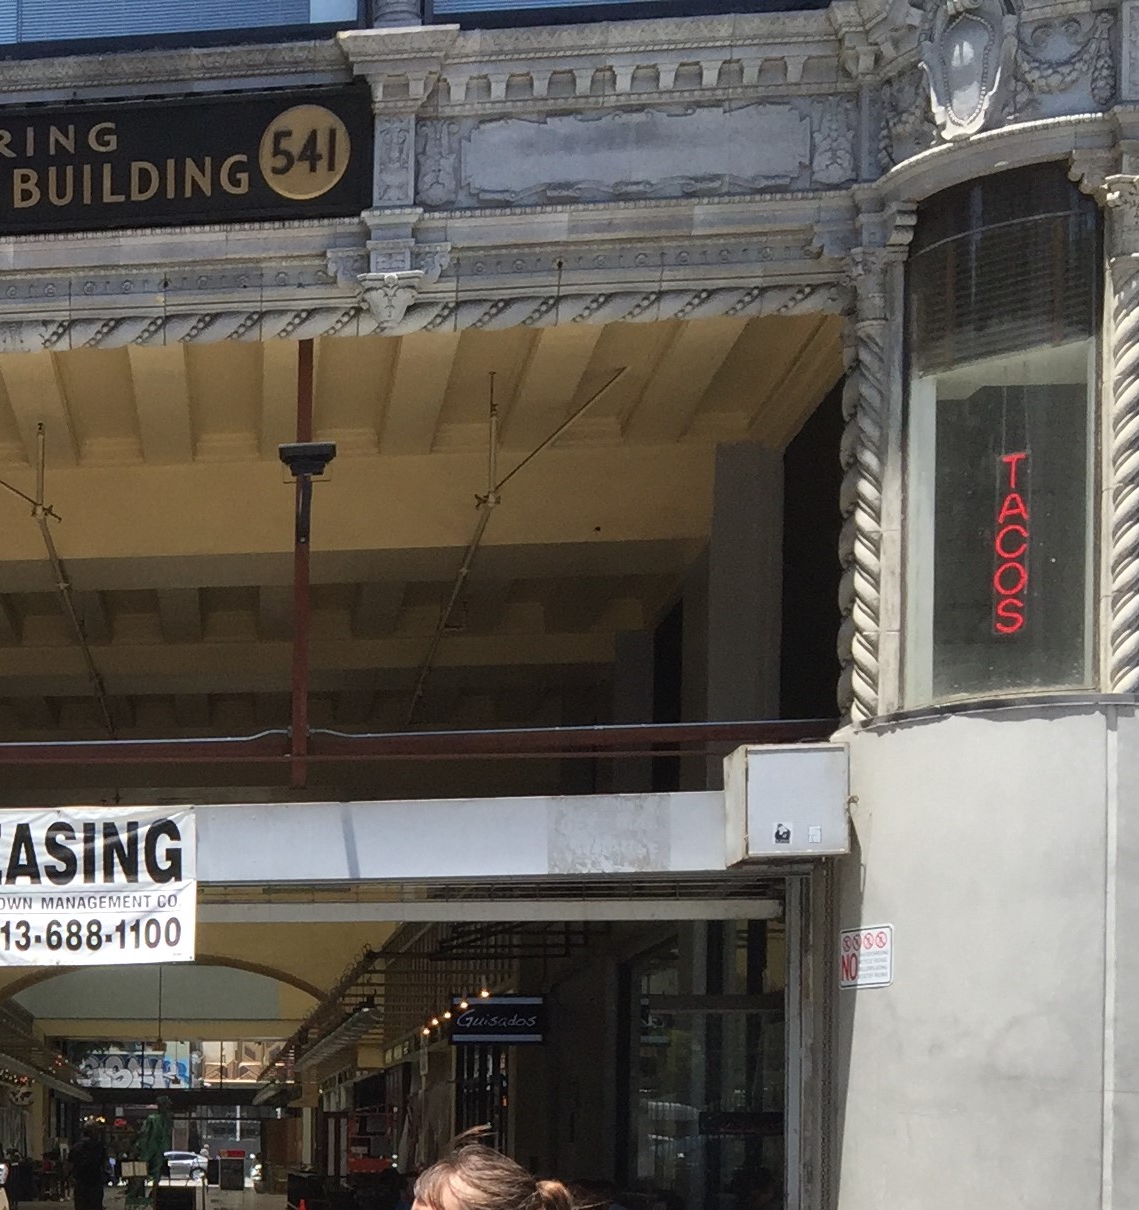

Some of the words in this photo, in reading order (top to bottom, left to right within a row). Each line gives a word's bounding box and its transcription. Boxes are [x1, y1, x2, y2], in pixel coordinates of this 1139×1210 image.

[14, 153, 249, 208] BUILDING
[270, 127, 337, 175] 541
[993, 452, 1029, 634] TACOS
[41, 895, 152, 909] MANAGEMENT
[841, 952, 857, 981] NO
[456, 1008, 537, 1028] Guisados
